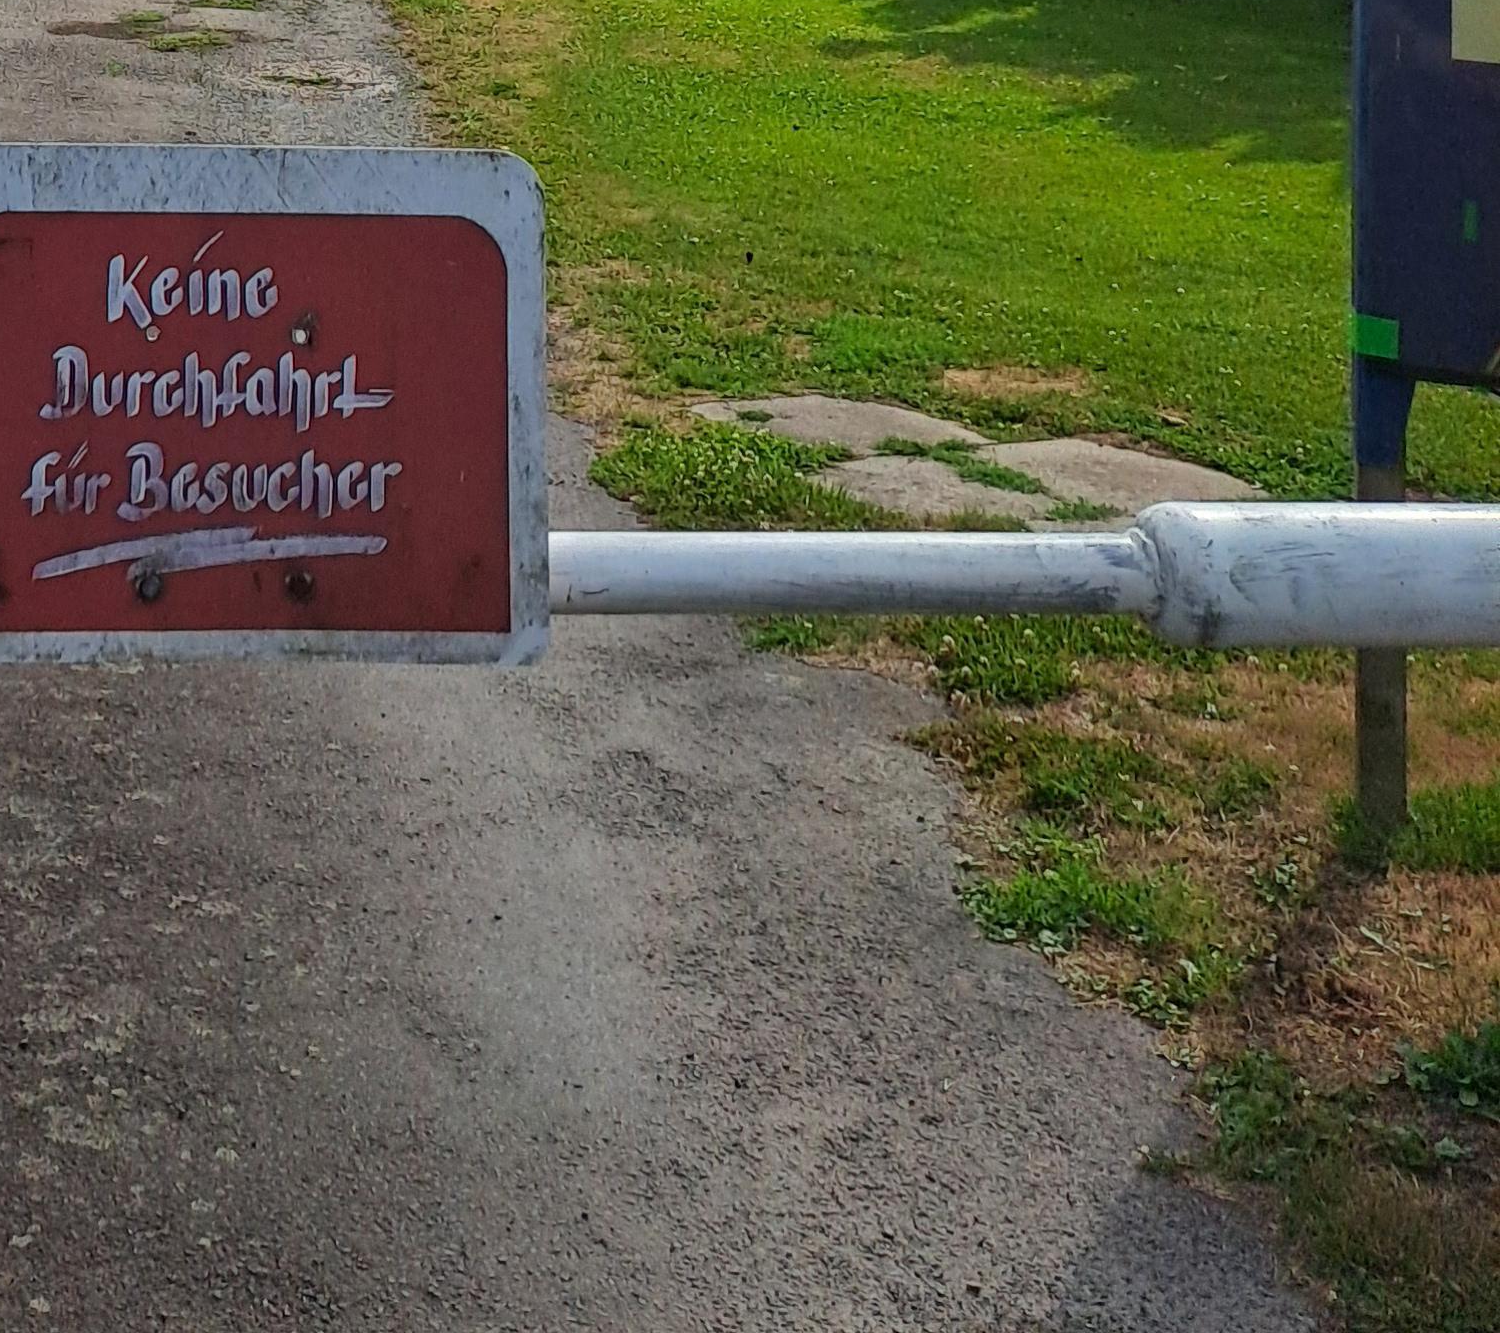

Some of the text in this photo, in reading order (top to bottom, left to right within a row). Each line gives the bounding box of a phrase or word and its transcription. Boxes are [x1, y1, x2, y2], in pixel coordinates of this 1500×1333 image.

[106, 230, 278, 330] Keine
[39, 345, 395, 432] Durchfahrt
[20, 441, 403, 522] für Besucher
